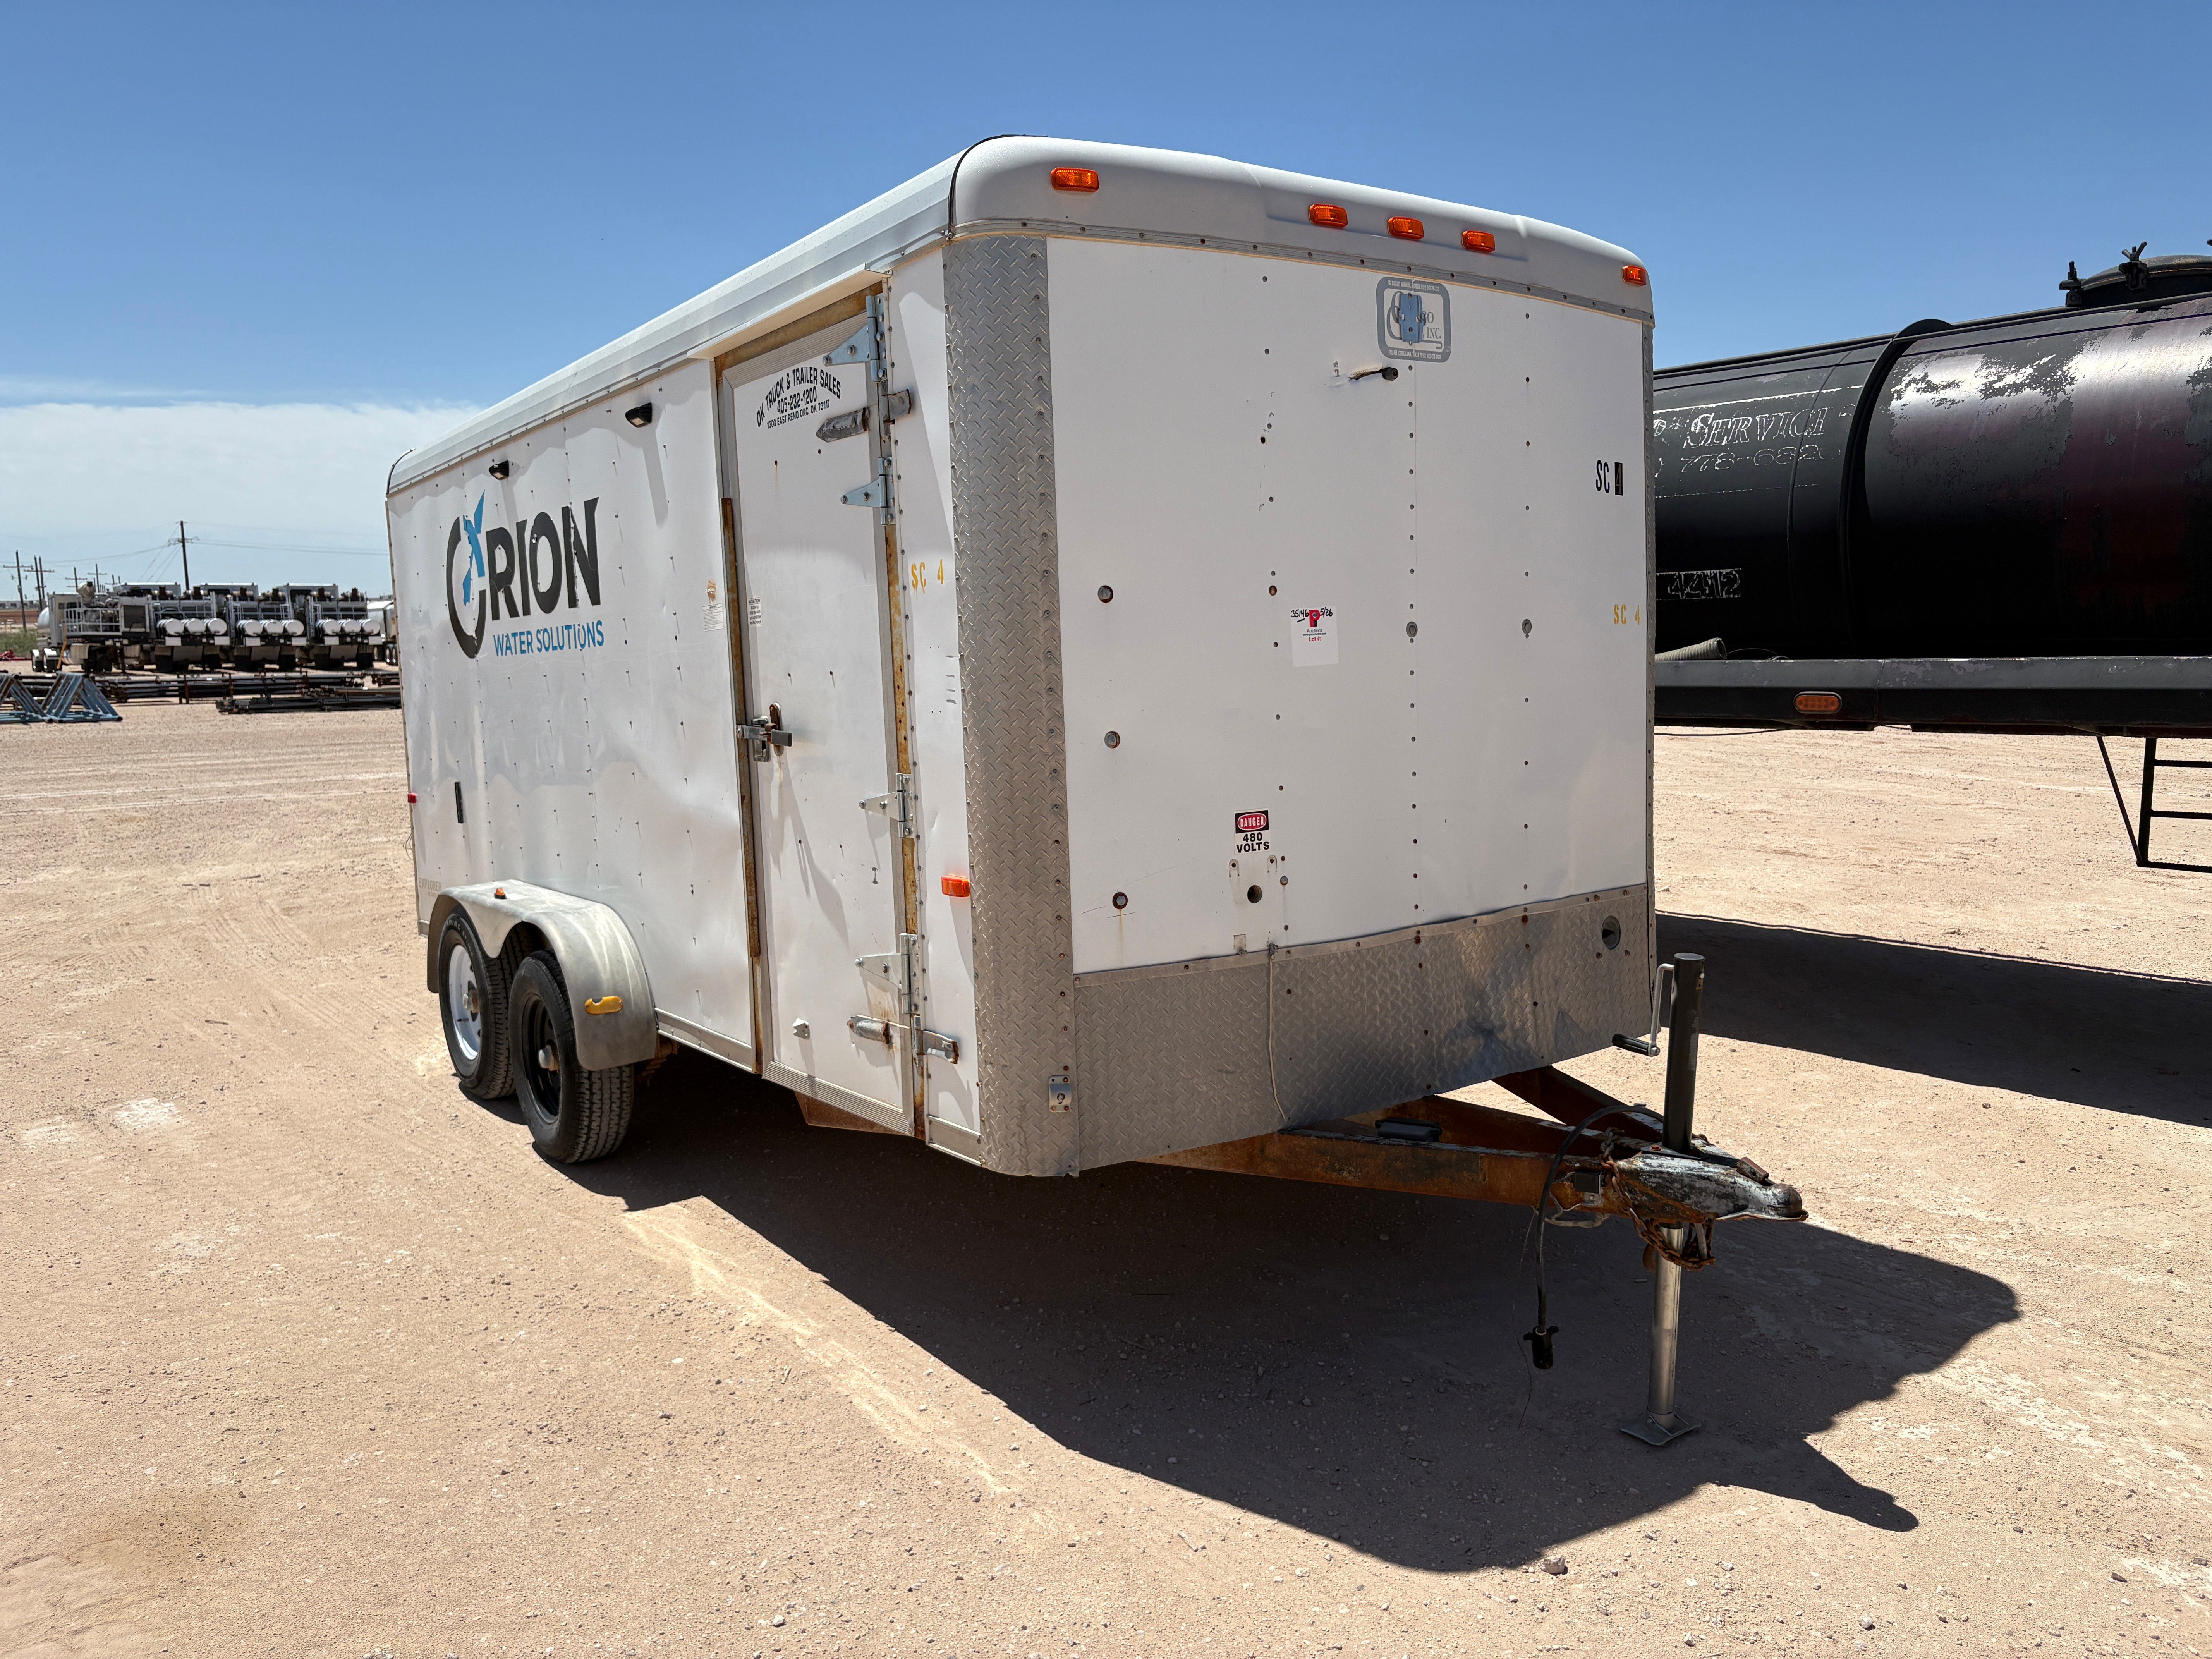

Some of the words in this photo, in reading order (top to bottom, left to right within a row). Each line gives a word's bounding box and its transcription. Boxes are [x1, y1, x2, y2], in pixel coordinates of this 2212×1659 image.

[1427, 327, 1441, 339] INC.
[757, 402, 765, 427] OK
[765, 377, 784, 411] TRUCK
[786, 373, 790, 390] &
[792, 367, 817, 386] TRAILER
[820, 369, 841, 399] SALES
[777, 386, 817, 415] 405-232-1200
[777, 415, 787, 425] EAST
[788, 410, 799, 421] RENO
[800, 407, 810, 416] OKC,
[811, 404, 817, 414] OK
[1595, 459, 1610, 494] SC
[1614, 462, 1623, 496] 4
[911, 562, 926, 594] SC
[937, 559, 944, 585] 4
[1291, 609, 1309, 618] 35146
[1319, 607, 1333, 618] 5/26
[1613, 604, 1626, 625] SC
[1635, 605, 1640, 625] 4
[493, 631, 534, 656] WATER
[536, 620, 604, 653] SOLUTIONS
[1240, 816, 1264, 828] DANGER
[1236, 841, 1269, 853] VOLTS
[1243, 832, 1262, 842] 480
